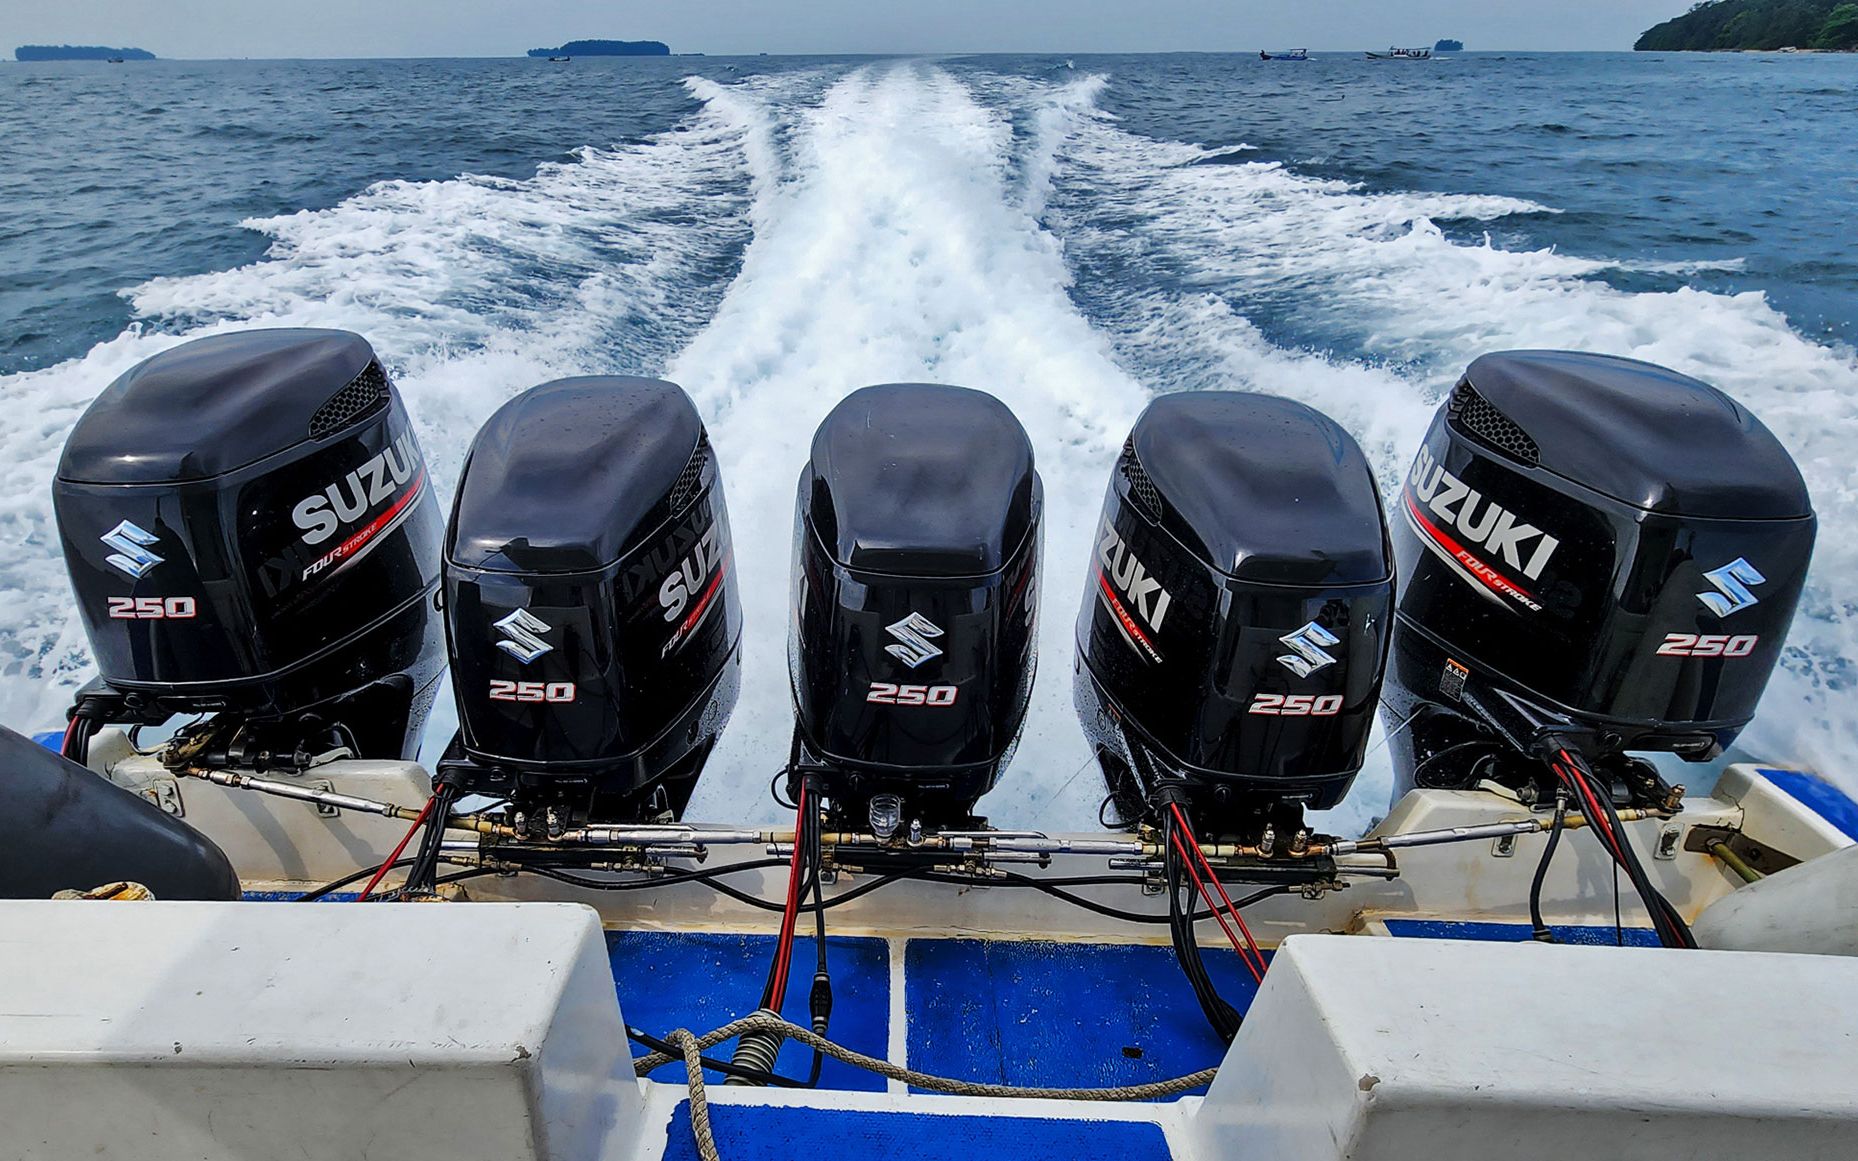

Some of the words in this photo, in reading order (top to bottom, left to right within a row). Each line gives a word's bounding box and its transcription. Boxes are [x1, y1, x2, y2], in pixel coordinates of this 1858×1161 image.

[292, 420, 420, 545] SUZUK
[1411, 443, 1560, 581] SUZUKI
[302, 546, 342, 581] FOUR
[342, 522, 377, 553] STROKE
[1455, 550, 1498, 581] FOUR
[1493, 578, 1543, 612] STROKE
[107, 596, 196, 619] 250
[1111, 597, 1136, 630] FOUR
[1132, 627, 1163, 664] STROKE
[1656, 633, 1759, 658] 250
[489, 679, 576, 703] 250
[866, 681, 958, 707] 250
[1248, 692, 1344, 716] 250
